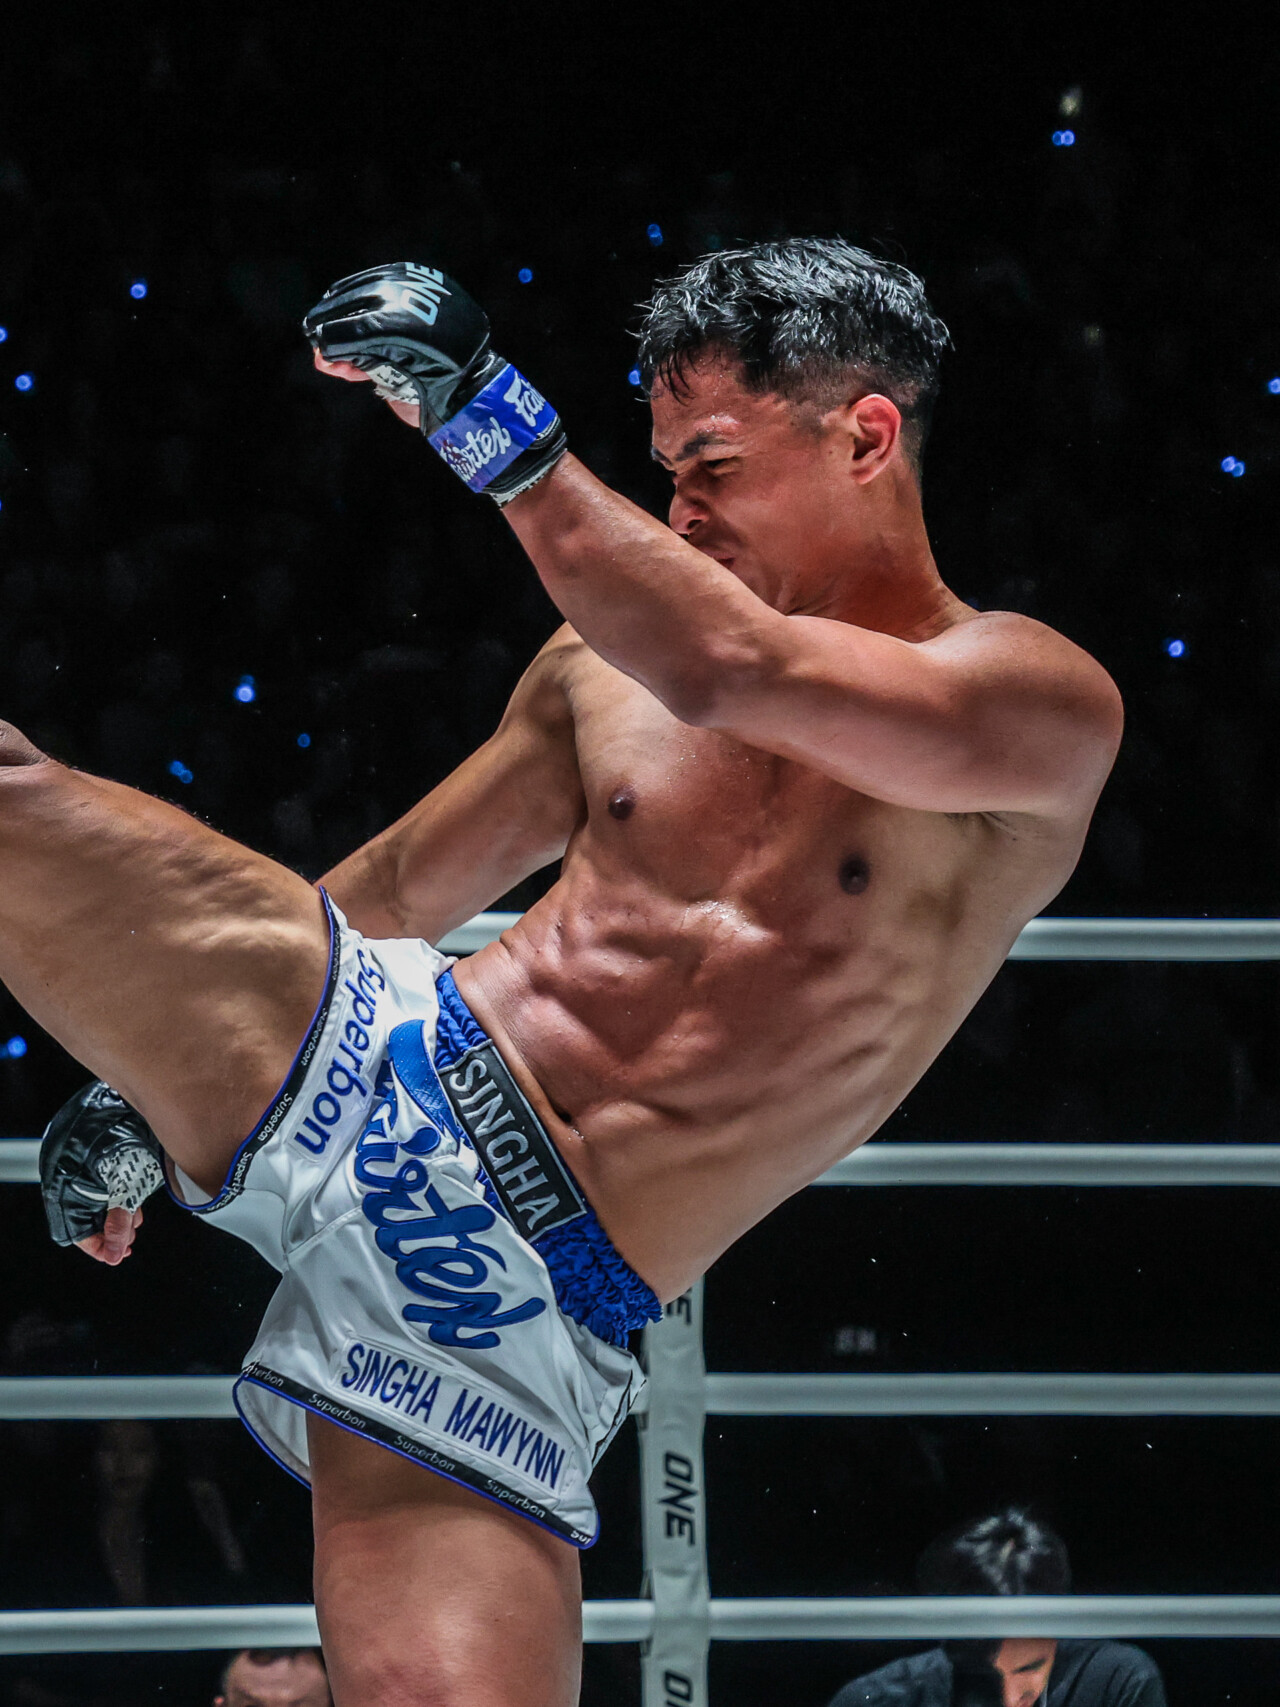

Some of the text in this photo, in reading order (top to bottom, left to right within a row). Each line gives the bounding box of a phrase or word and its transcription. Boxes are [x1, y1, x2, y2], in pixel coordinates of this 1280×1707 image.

[398, 261, 452, 326] ONE
[293, 948, 386, 1156] Superbon
[448, 1058, 560, 1231] SINGHA
[308, 1392, 367, 1430] Superbon
[340, 1342, 566, 1491] SINGHA MAWYNN
[393, 1434, 456, 1473] Superbon
[483, 1479, 547, 1519] Superbon
[659, 1451, 697, 1546] ONE
